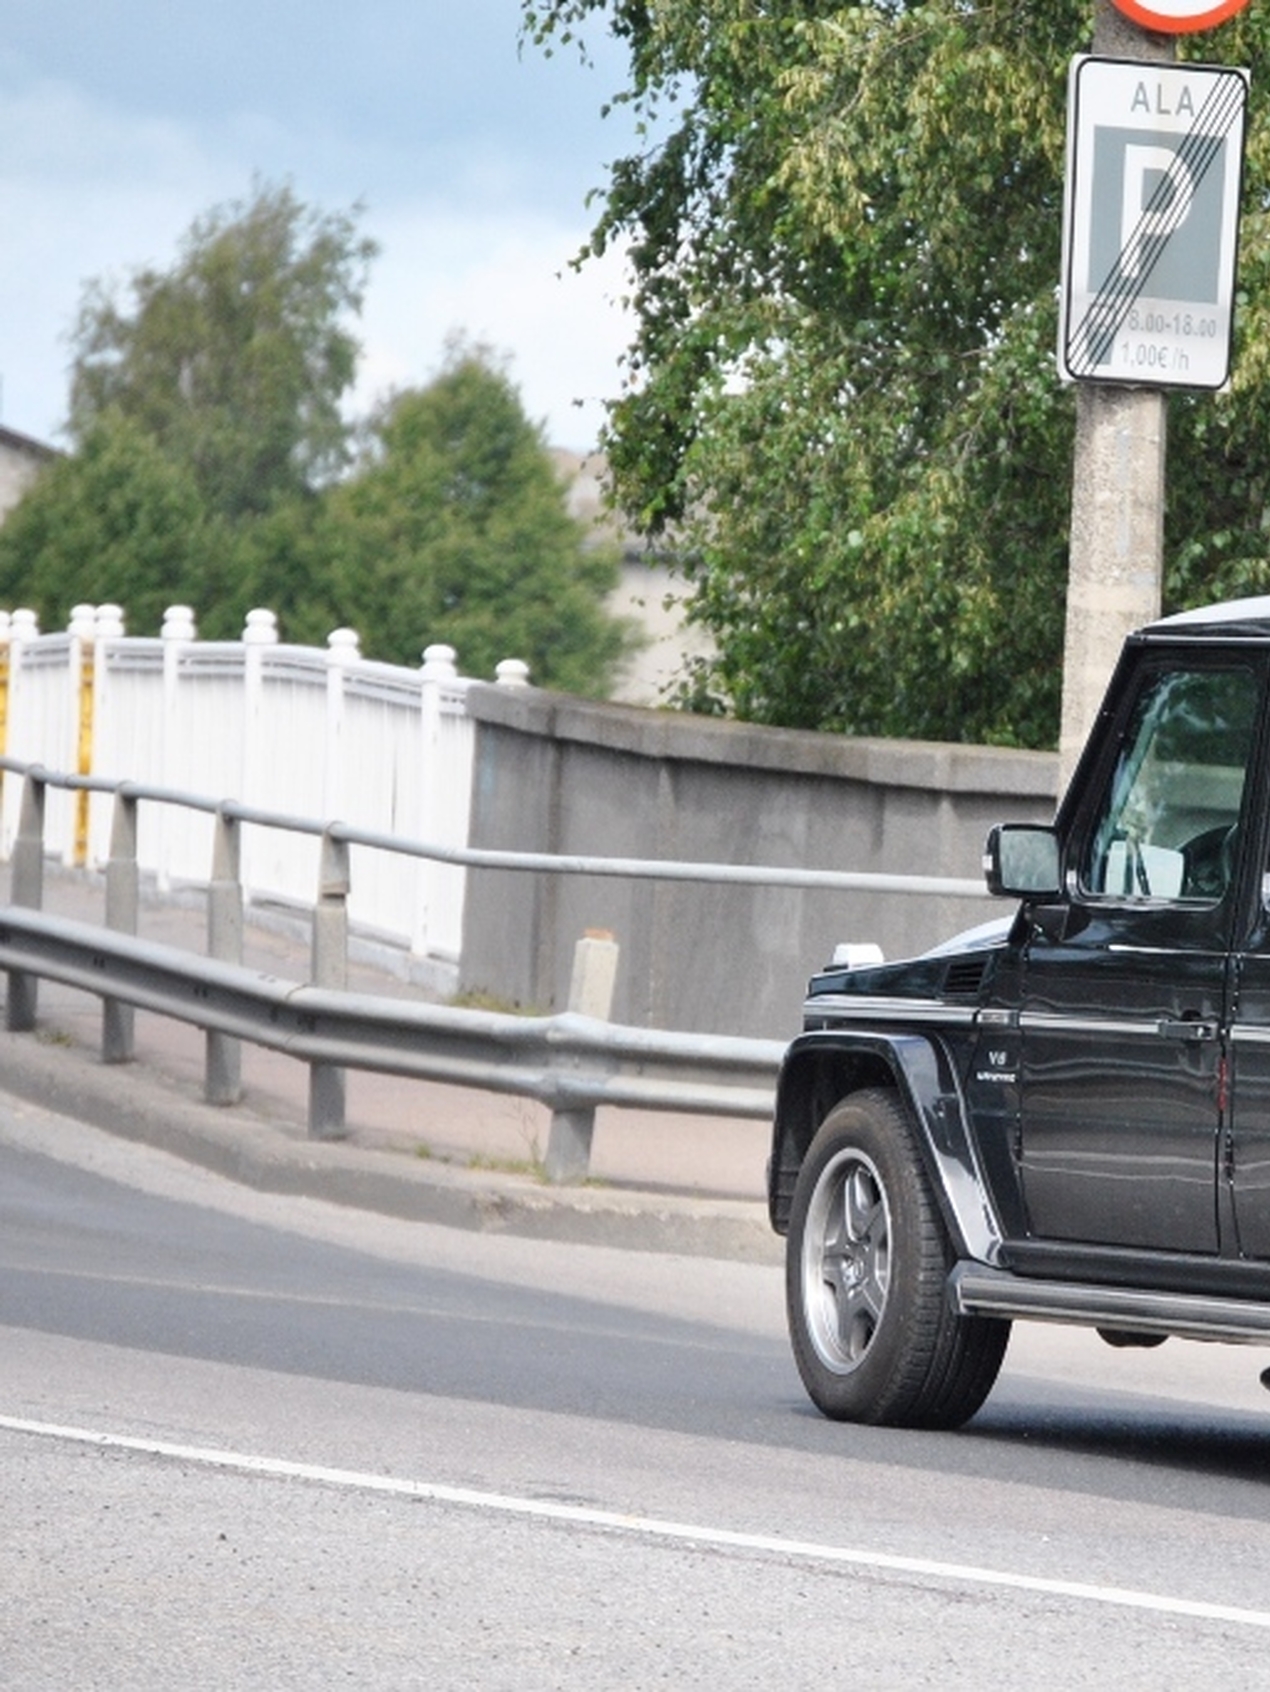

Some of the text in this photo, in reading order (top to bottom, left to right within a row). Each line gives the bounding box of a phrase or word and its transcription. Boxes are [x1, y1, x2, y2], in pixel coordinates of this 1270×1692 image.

[1130, 81, 1195, 117] ALA
[1120, 143, 1194, 279] P
[1128, 309, 1217, 338] 8.00-18.00
